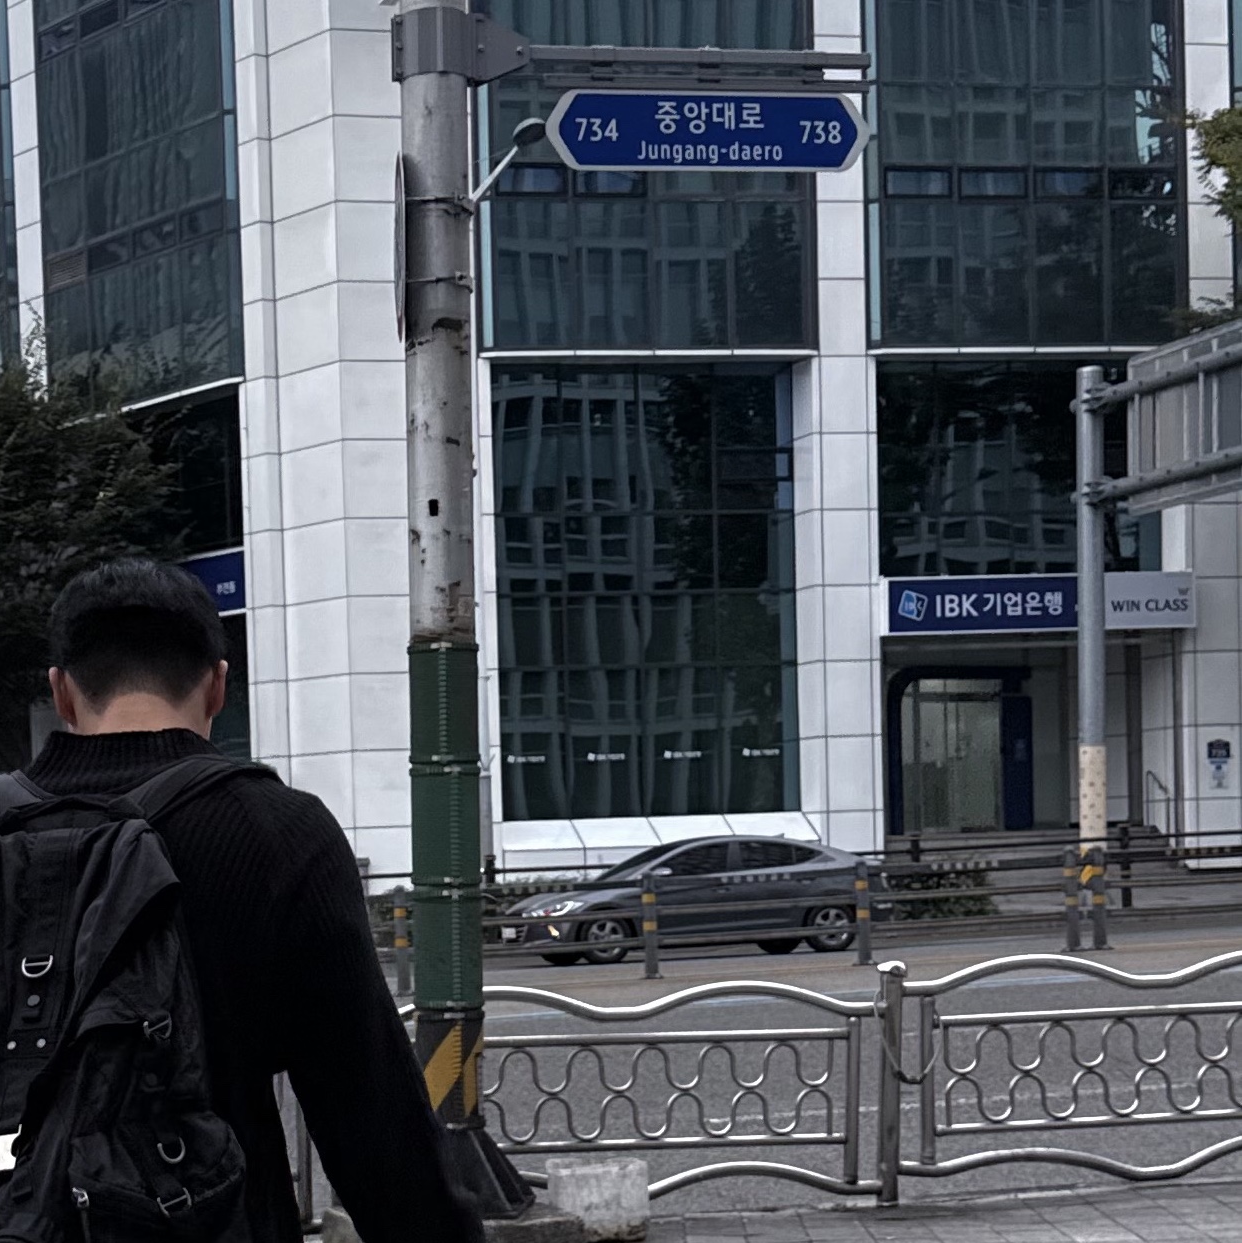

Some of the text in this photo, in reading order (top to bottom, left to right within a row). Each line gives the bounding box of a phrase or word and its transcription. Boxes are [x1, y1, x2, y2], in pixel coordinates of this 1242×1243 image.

[654, 101, 765, 134] 중앙대로
[575, 118, 619, 142] 734
[799, 121, 842, 144] 738
[637, 141, 783, 164] Jungang-daero
[935, 591, 1063, 618] IBK 기업은행
[1111, 599, 1188, 612] WIN CLASS
